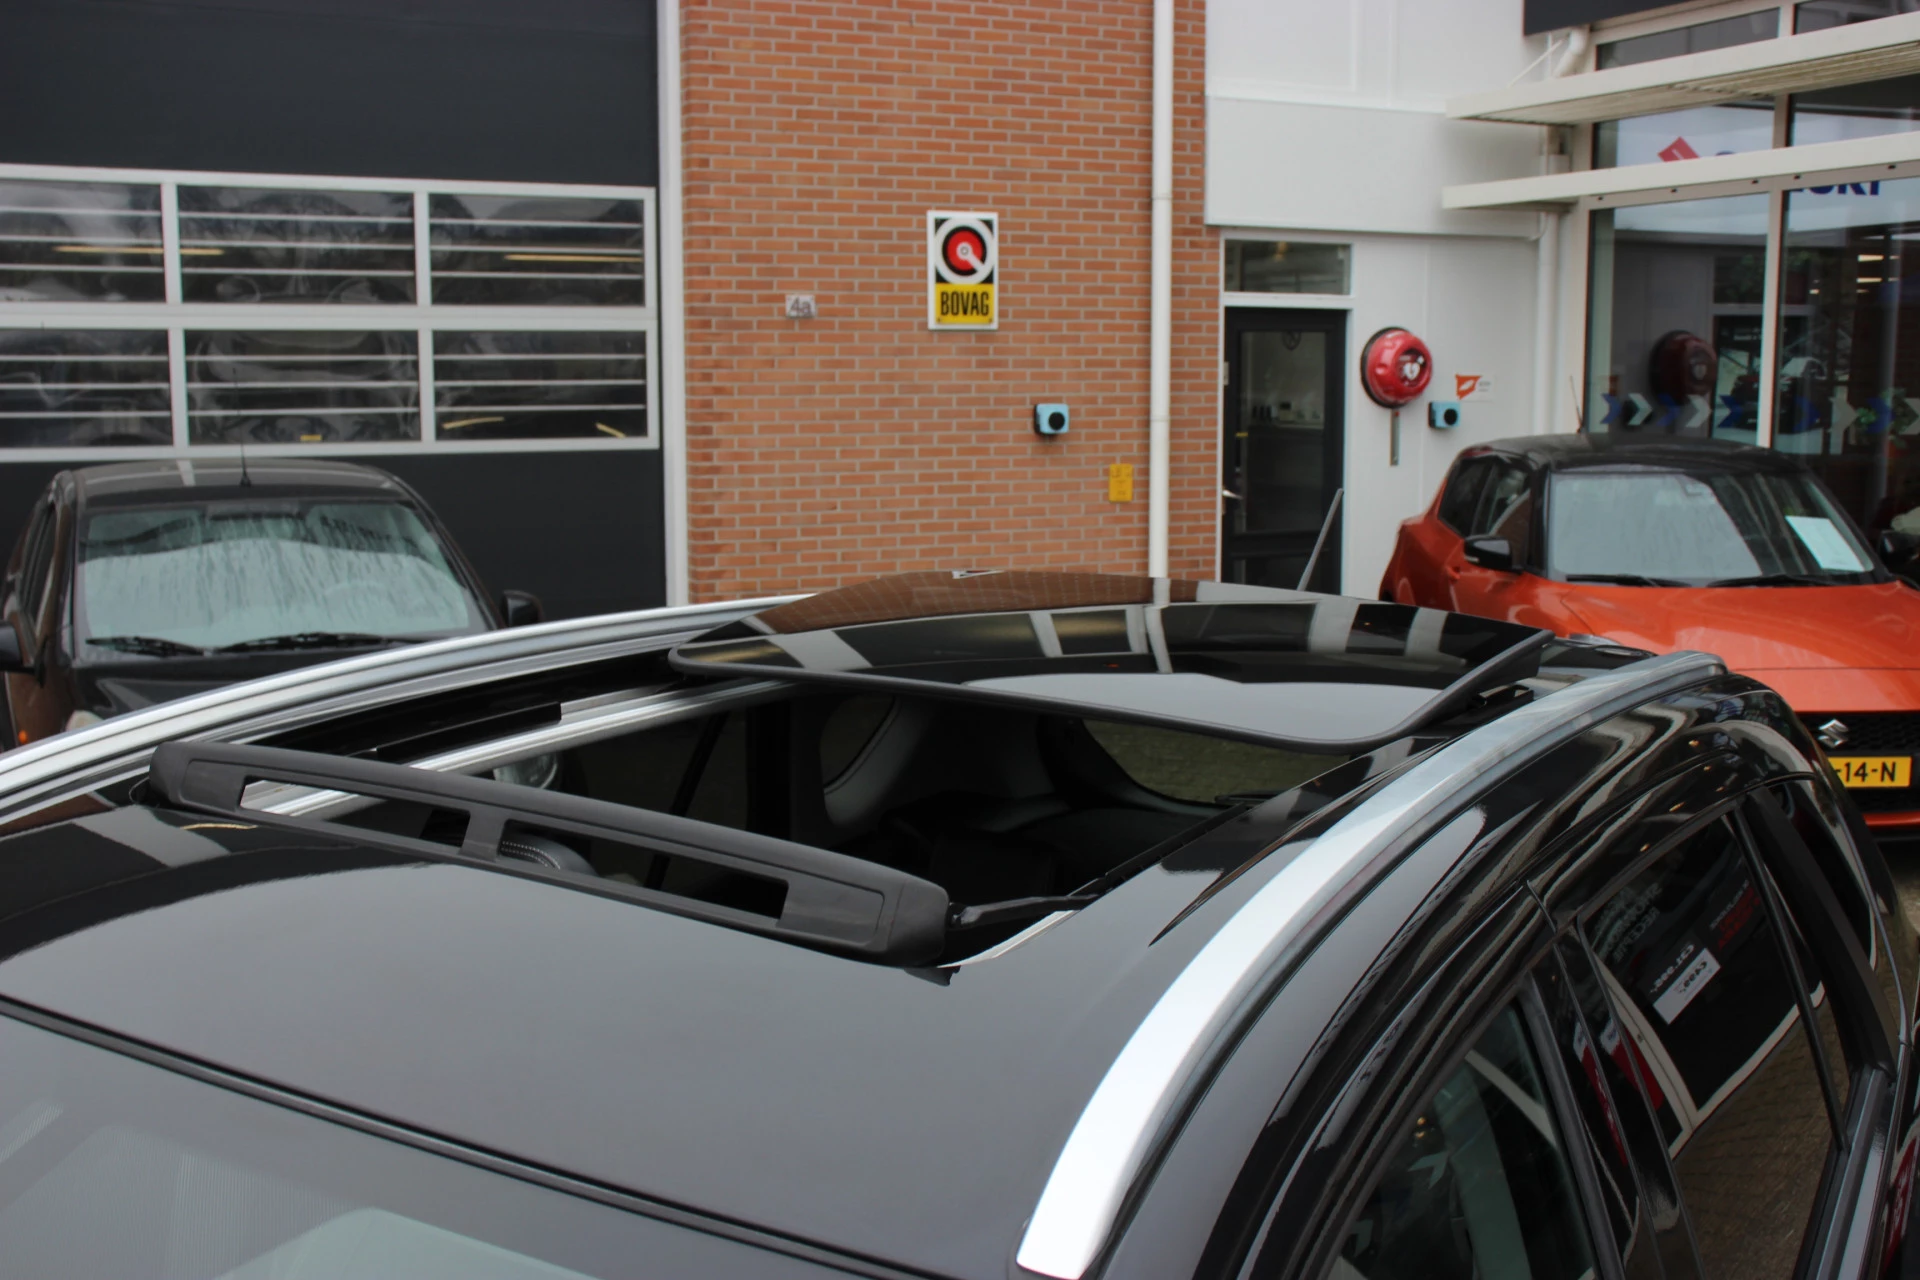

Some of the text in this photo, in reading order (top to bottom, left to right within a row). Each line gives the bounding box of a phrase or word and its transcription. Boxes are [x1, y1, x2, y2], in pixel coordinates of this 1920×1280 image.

[790, 296, 812, 317] 4a
[940, 290, 990, 317] BOVAG
[1835, 761, 1897, 783] -14-N
